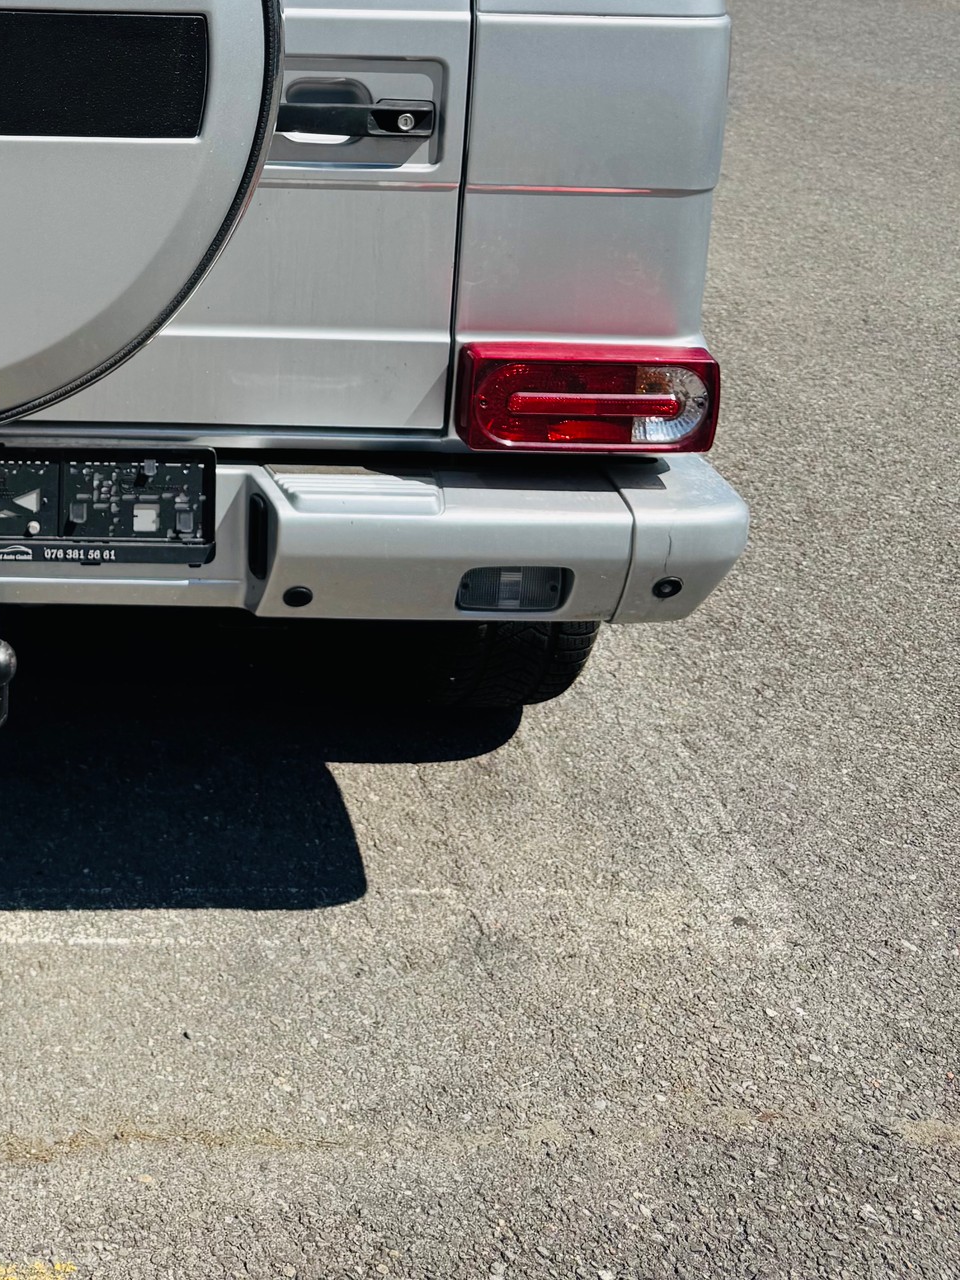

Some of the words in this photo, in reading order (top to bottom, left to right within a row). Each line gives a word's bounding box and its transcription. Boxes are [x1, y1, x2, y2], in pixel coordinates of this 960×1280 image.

[44, 548, 63, 559] 076
[66, 548, 84, 559] 381
[88, 549, 100, 559] 56
[103, 549, 116, 560] 61
